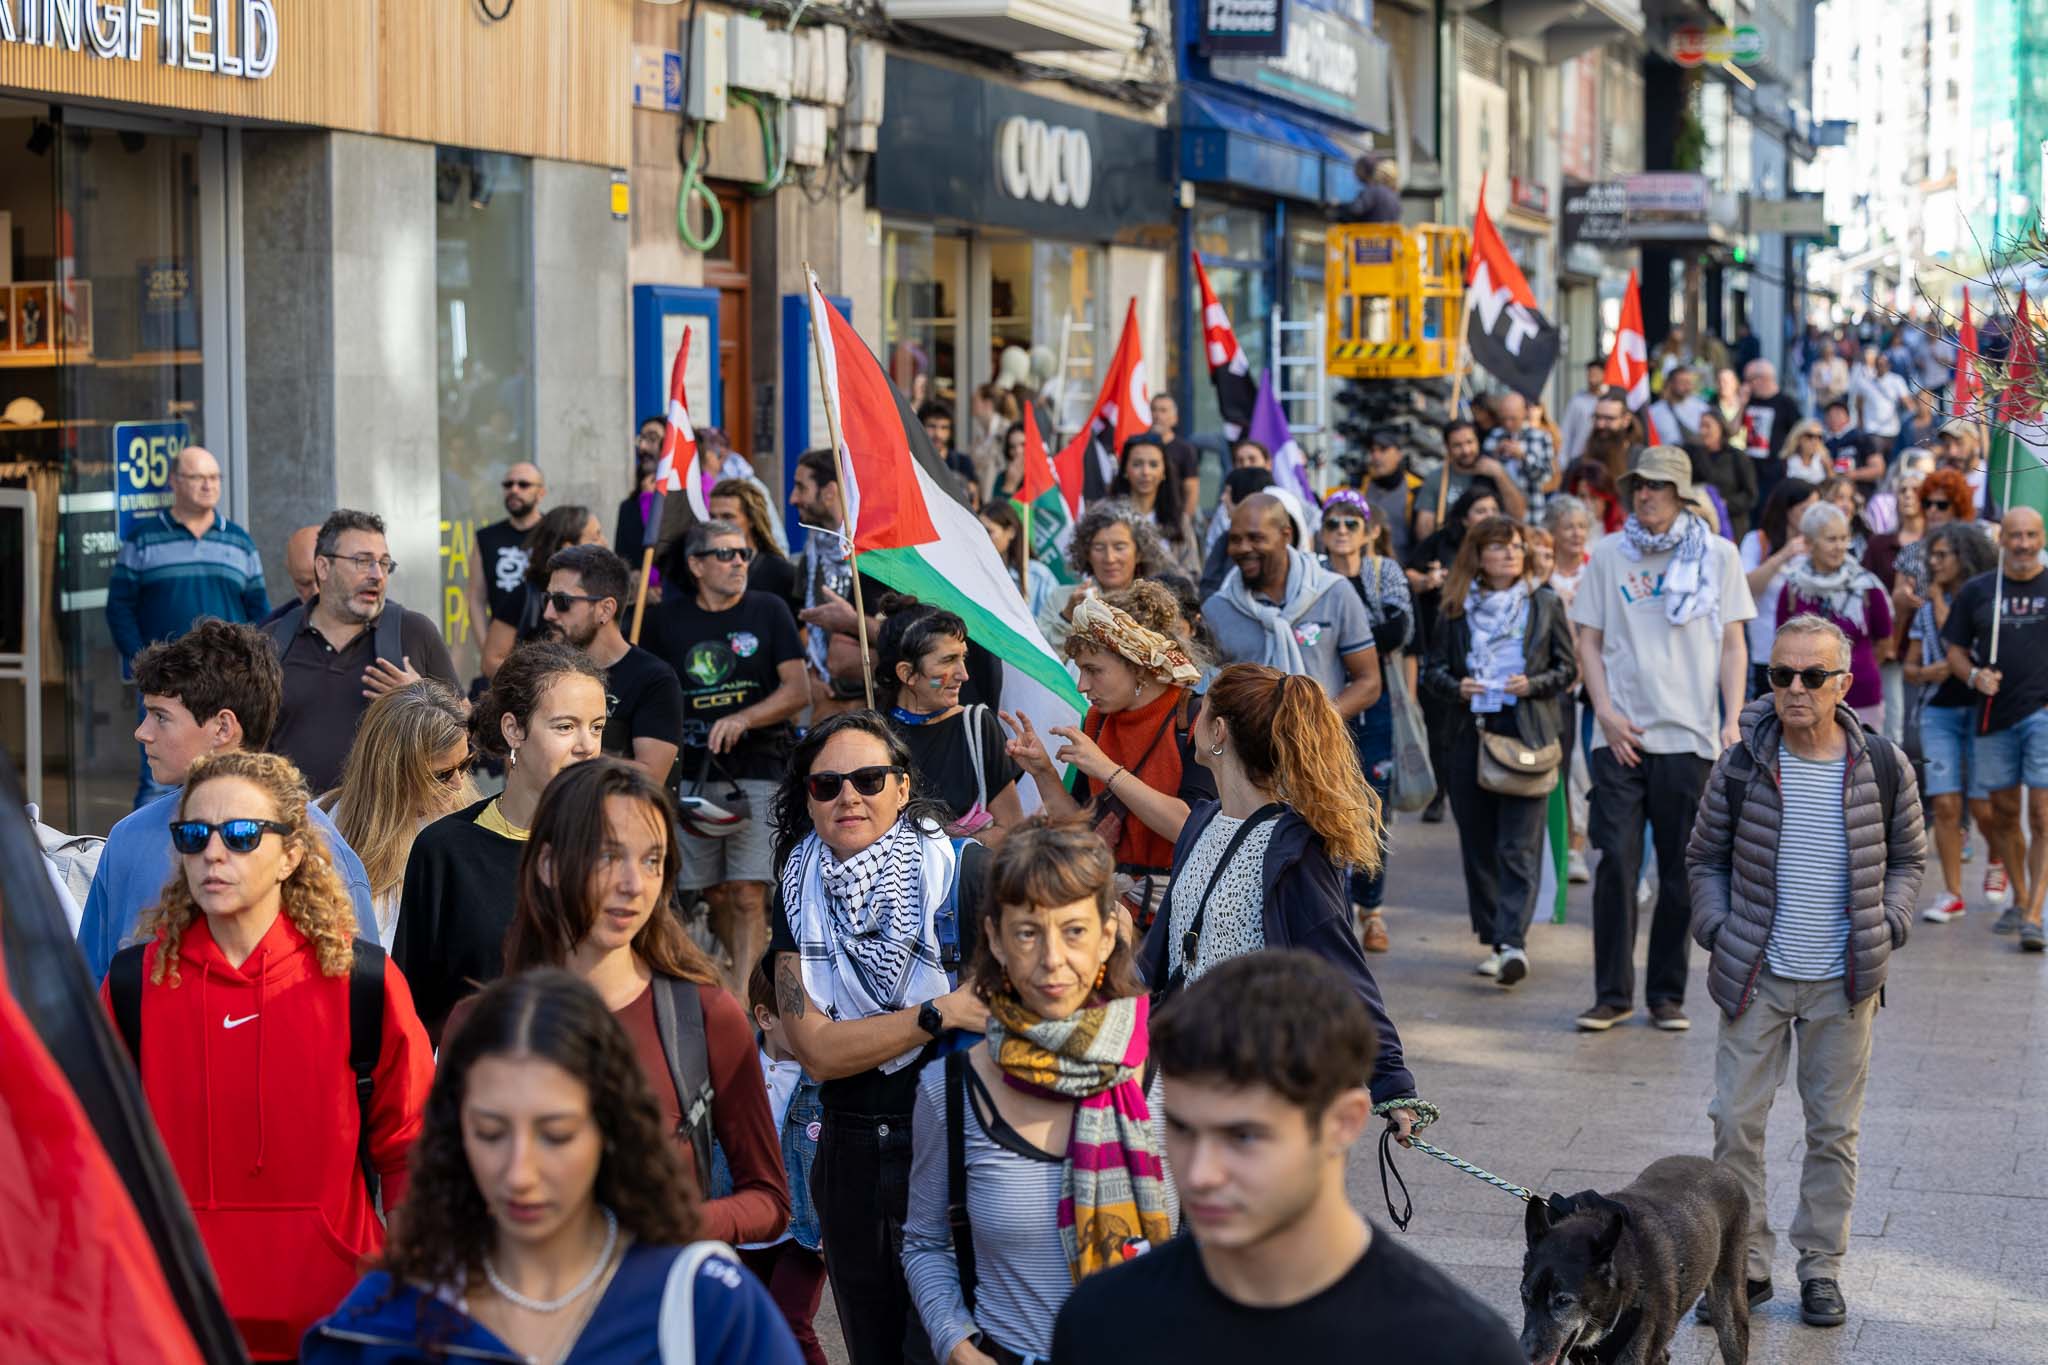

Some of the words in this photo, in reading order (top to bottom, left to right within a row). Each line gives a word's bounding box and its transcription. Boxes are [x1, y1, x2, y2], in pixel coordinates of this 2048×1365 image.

[0, 0, 278, 79] INGFIELD
[1208, 14, 1276, 32] House
[1001, 115, 1092, 209] COCO
[693, 690, 748, 709] CGT
